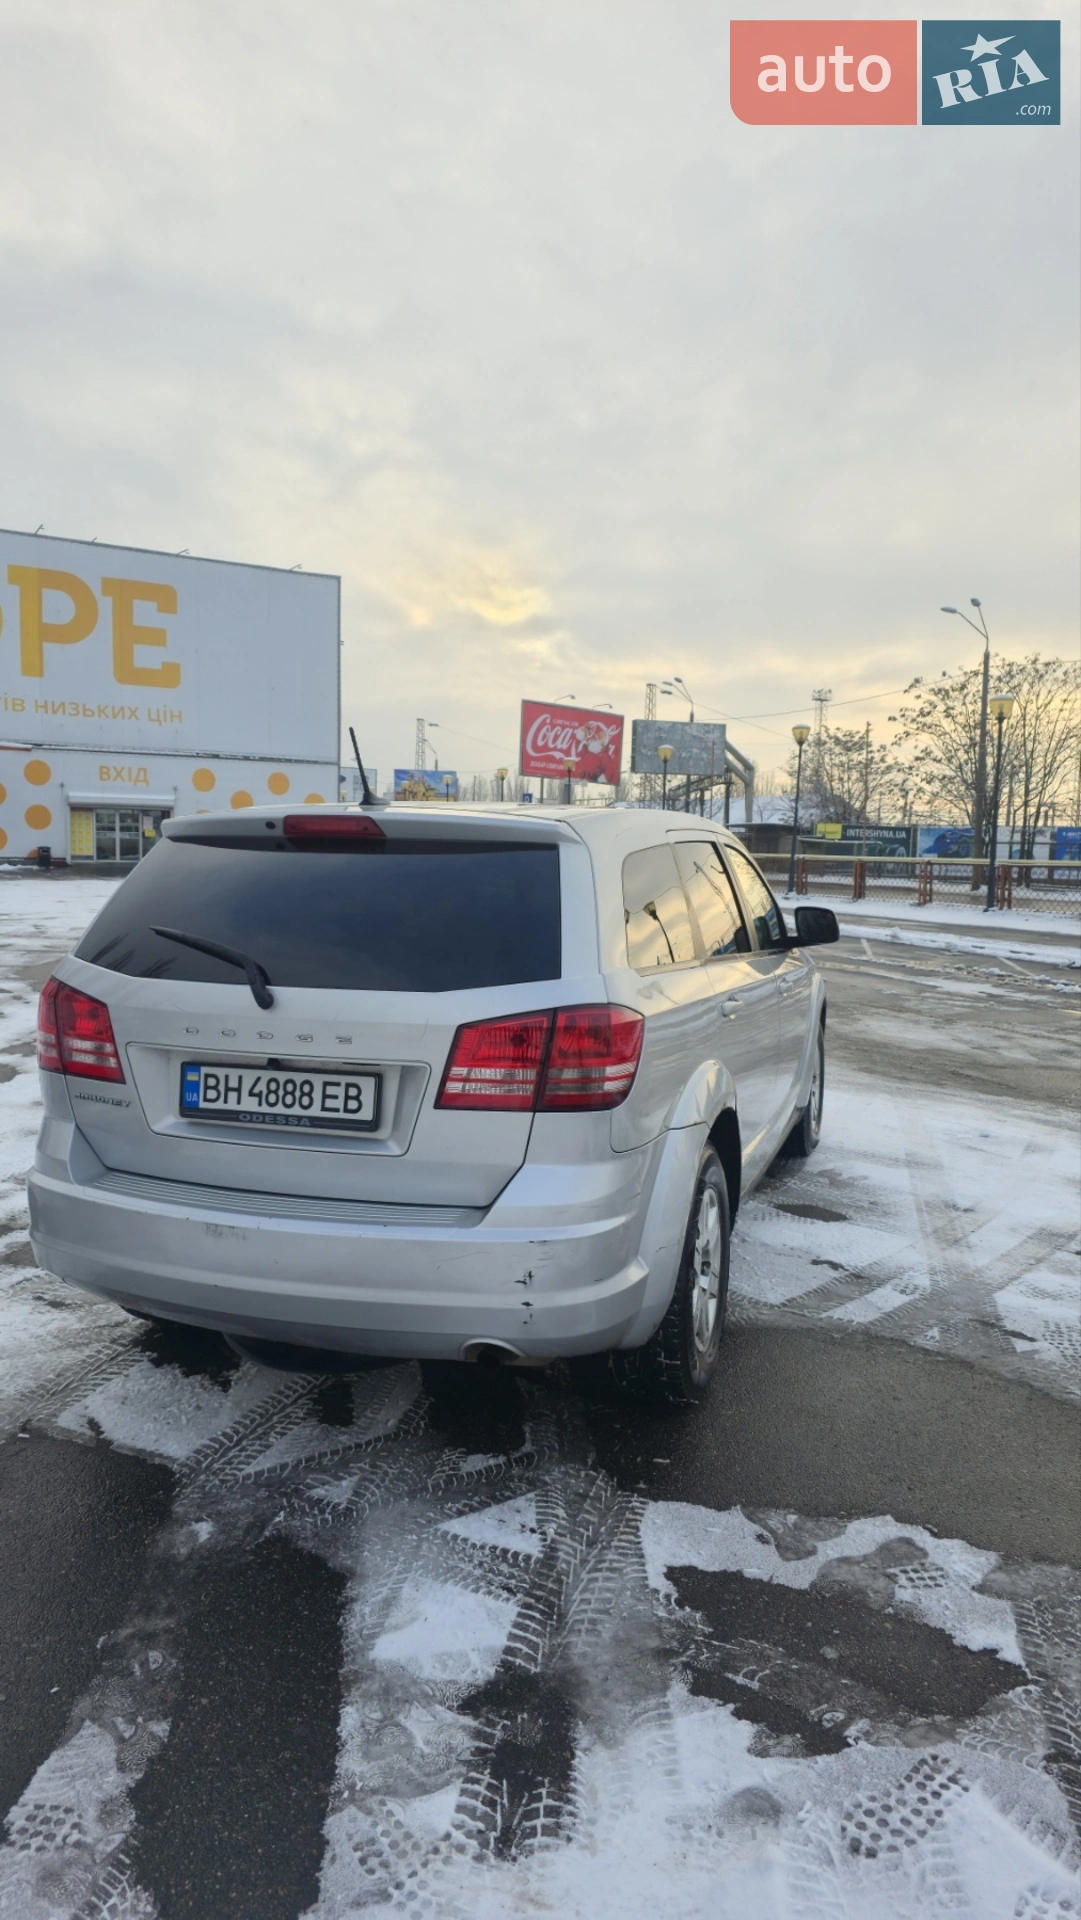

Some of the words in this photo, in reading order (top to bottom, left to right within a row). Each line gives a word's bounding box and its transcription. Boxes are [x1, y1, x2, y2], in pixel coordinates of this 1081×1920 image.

[0, 563, 182, 689] РЕ
[0, 691, 26, 713] ів
[34, 698, 140, 721] низьких
[147, 704, 183, 727] цін
[98, 765, 150, 788] ВХІД
[846, 828, 907, 839] INTERSHYNA.UA
[184, 1026, 353, 1045] DODGE
[185, 1092, 199, 1102] UA
[202, 1073, 243, 1106] BH
[247, 1075, 315, 1111] 4888
[320, 1080, 363, 1115] EB
[238, 1112, 311, 1126] ODESSA
